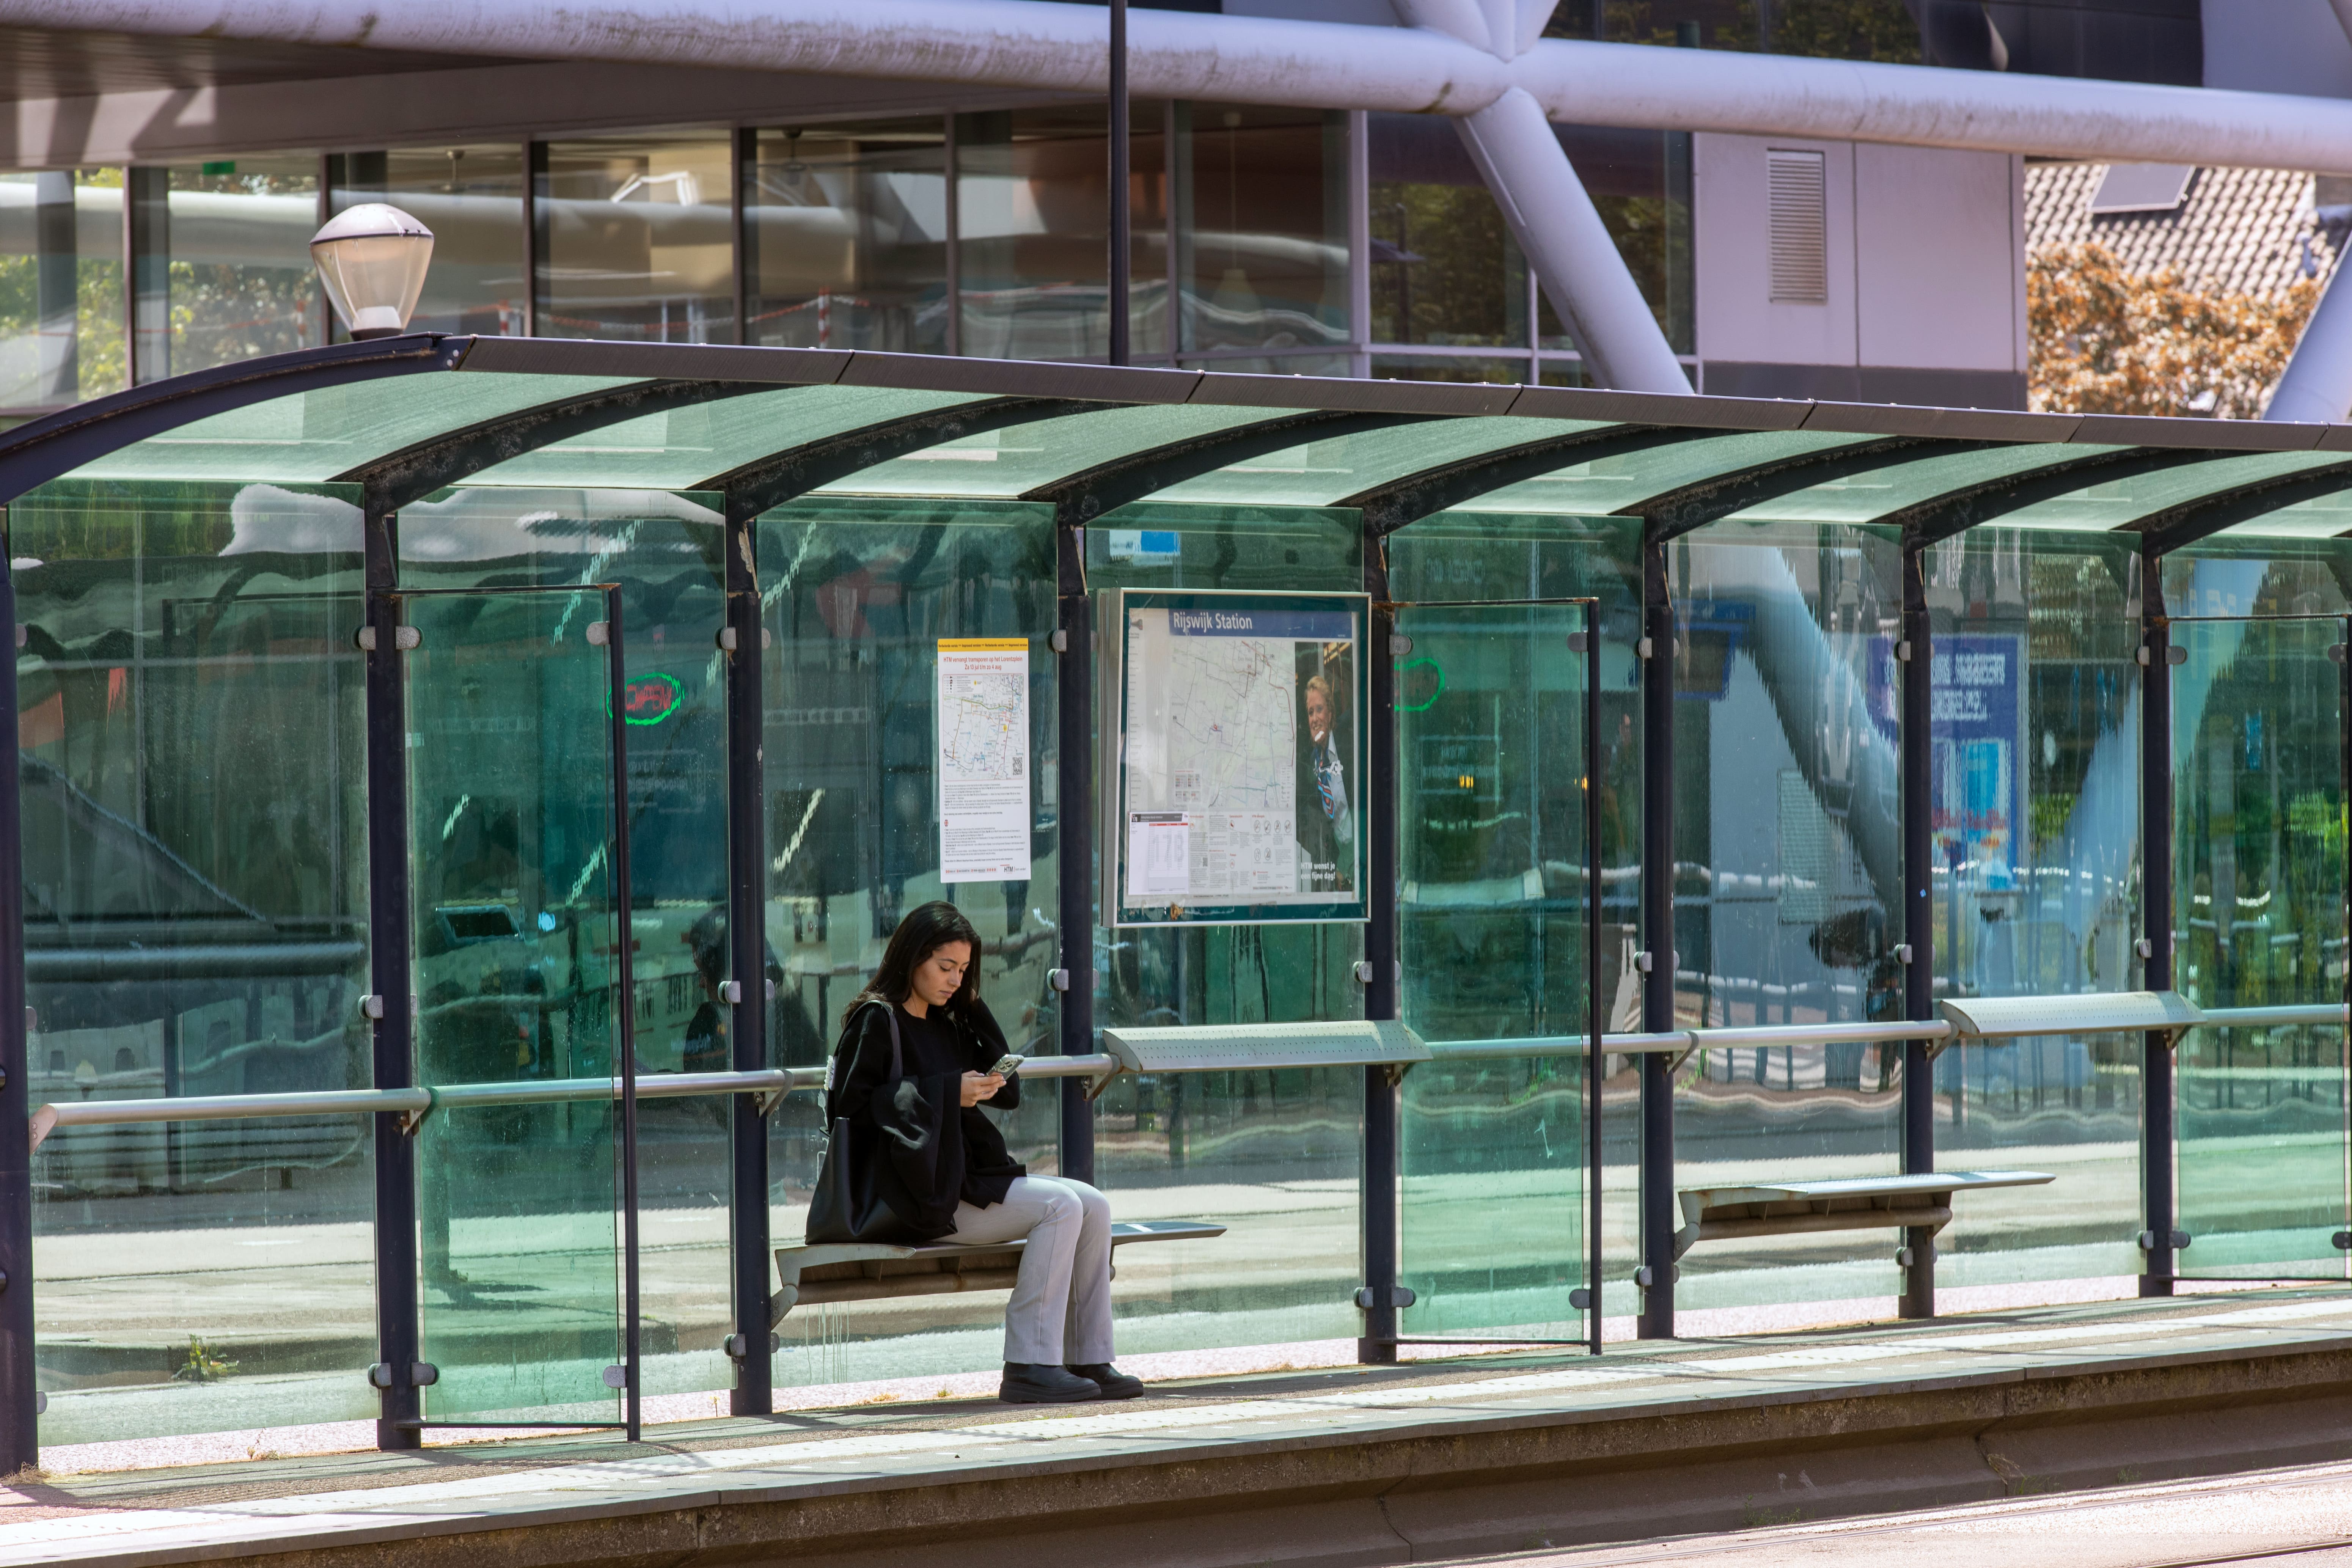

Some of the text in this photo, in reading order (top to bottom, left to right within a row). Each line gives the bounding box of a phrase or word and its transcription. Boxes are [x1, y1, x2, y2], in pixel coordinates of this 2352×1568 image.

[1174, 612, 1252, 633] Rijswijk Station
[1330, 861, 1335, 871] je
[1312, 871, 1323, 881] fijne
[1324, 872, 1335, 881] dag!
